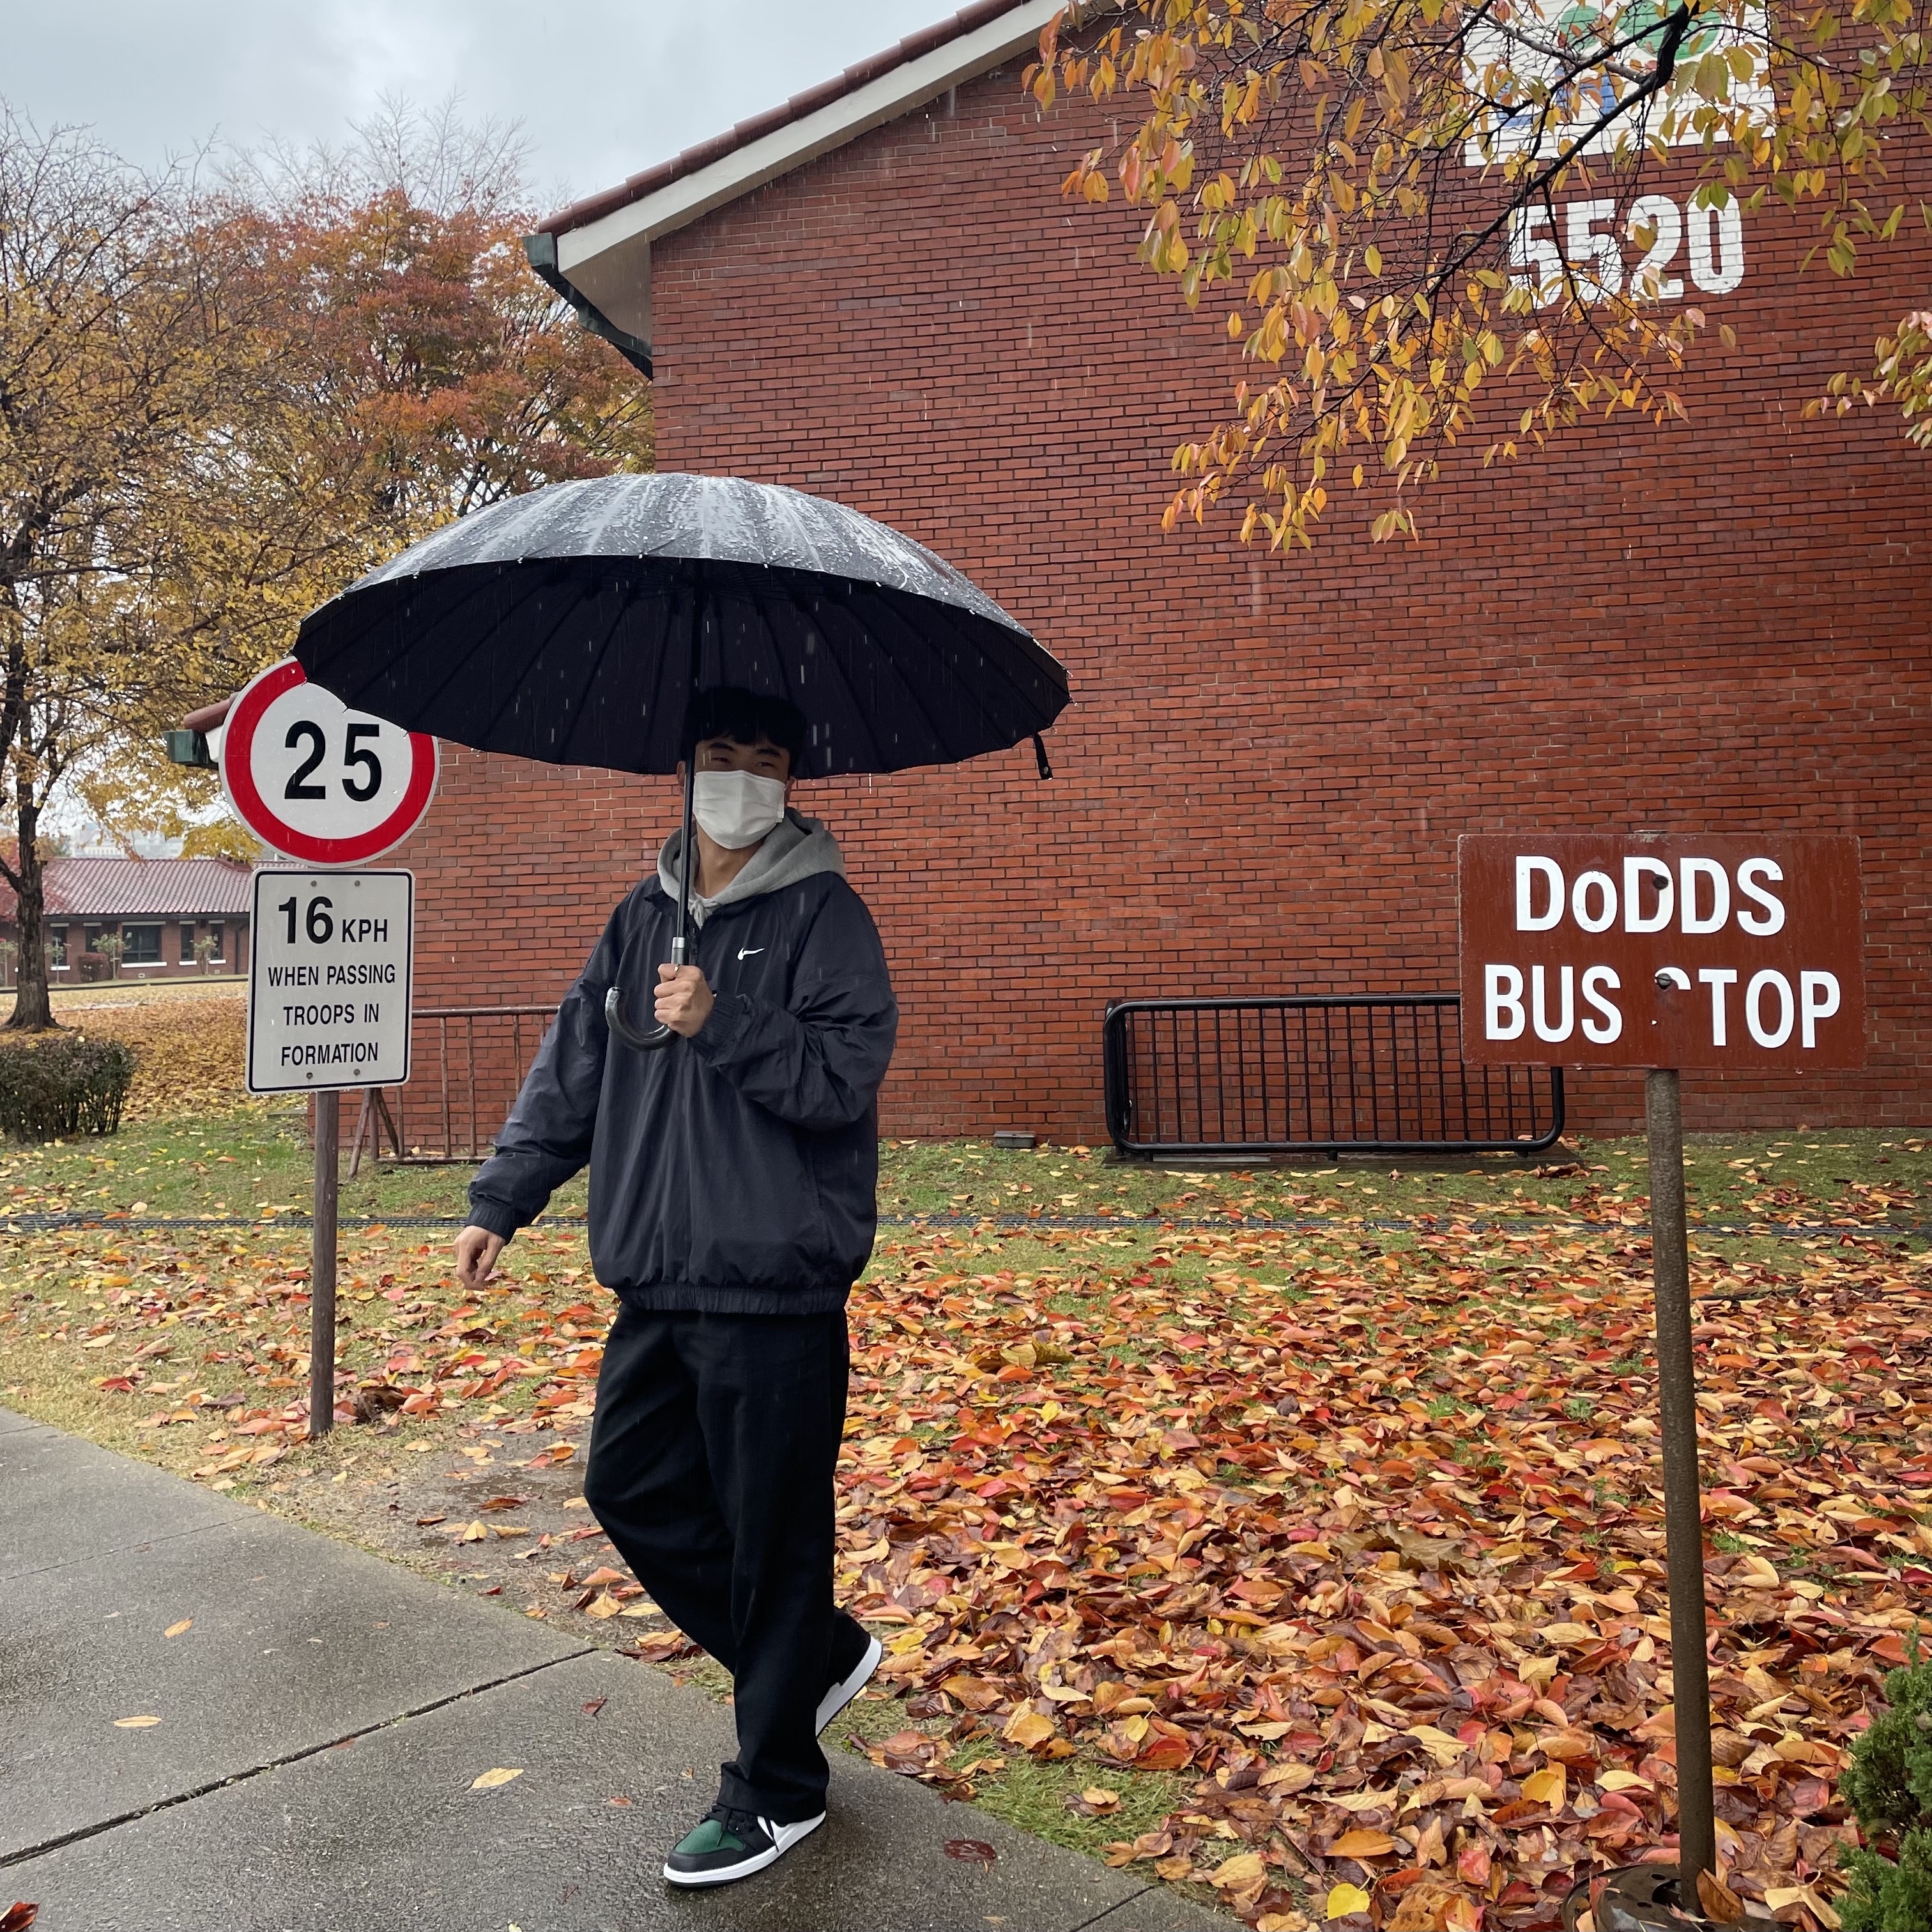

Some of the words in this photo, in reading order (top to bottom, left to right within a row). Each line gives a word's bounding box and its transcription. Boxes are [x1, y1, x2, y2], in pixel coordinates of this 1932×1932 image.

[1508, 191, 1745, 309] 5520
[284, 720, 382, 802] 25
[278, 896, 334, 944] 16
[342, 919, 388, 943] KPH
[1515, 855, 1786, 936] DoDDS
[268, 965, 319, 987] WHEN
[326, 963, 395, 986] PASSING
[1485, 964, 1622, 1045] BUS
[282, 1004, 355, 1026] TROOPS
[364, 1003, 379, 1023] IN
[281, 1042, 378, 1066] FORMATION
